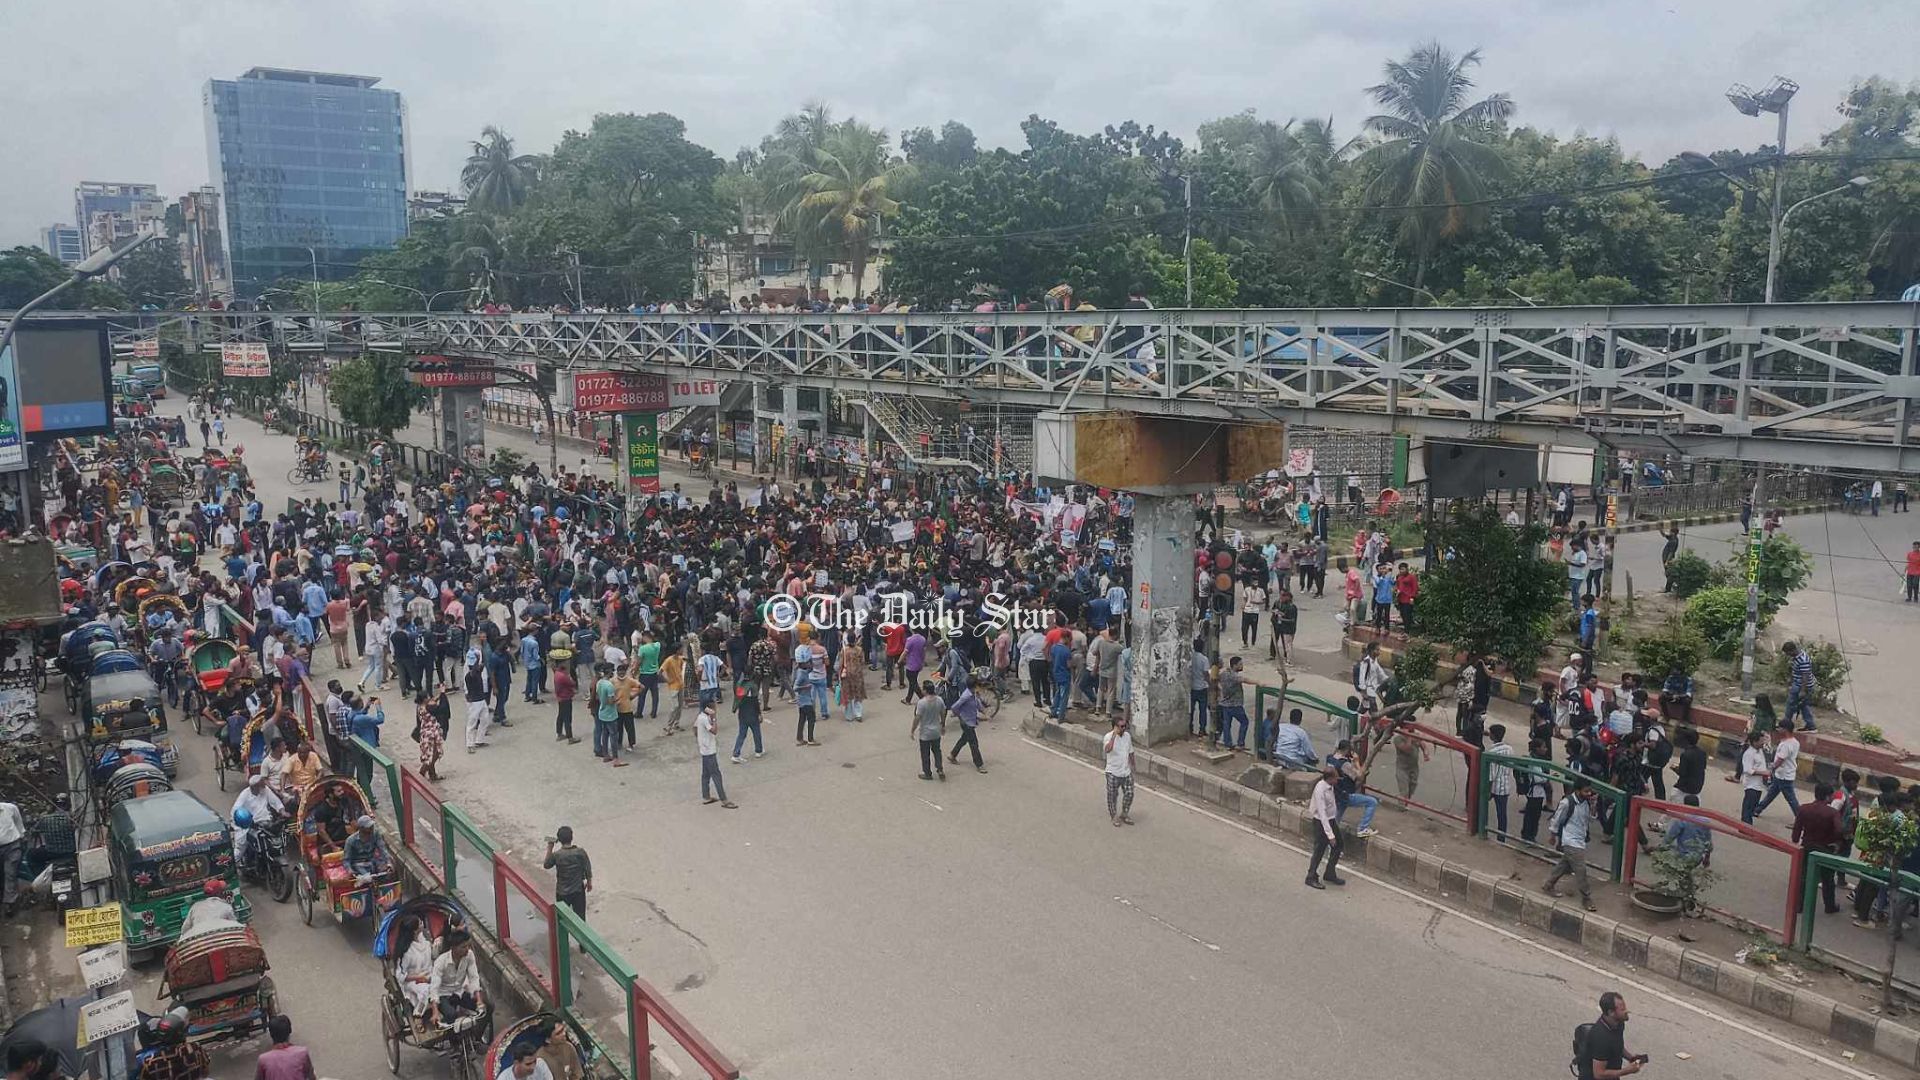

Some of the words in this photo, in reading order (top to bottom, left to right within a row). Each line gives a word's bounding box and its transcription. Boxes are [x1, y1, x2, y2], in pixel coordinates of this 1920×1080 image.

[672, 382, 691, 396] TO
[694, 379, 716, 395] LET
[579, 391, 665, 407] 01977-886788
